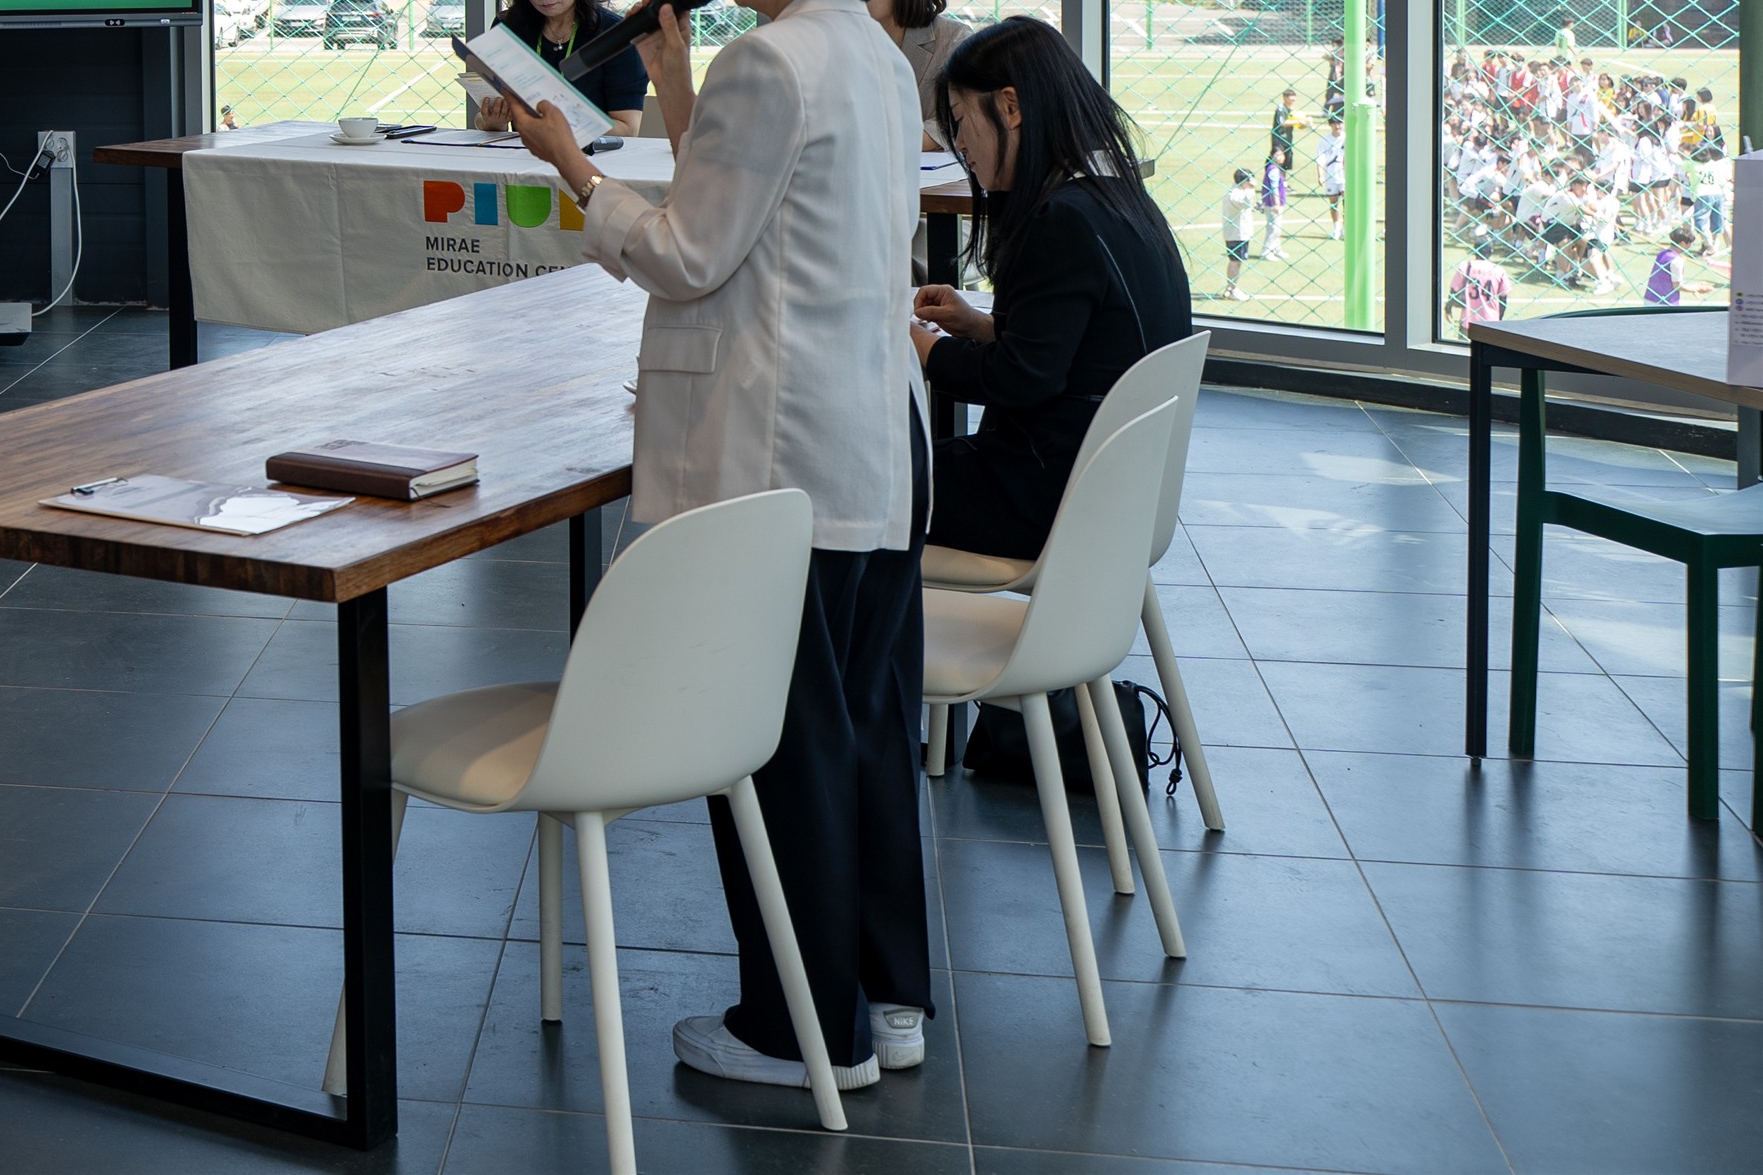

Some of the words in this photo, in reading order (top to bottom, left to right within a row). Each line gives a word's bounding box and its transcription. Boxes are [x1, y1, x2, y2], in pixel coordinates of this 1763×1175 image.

[425, 236, 481, 254] MIRAE
[426, 257, 528, 278] EDUCATION
[893, 1017, 915, 1025] NIKE
